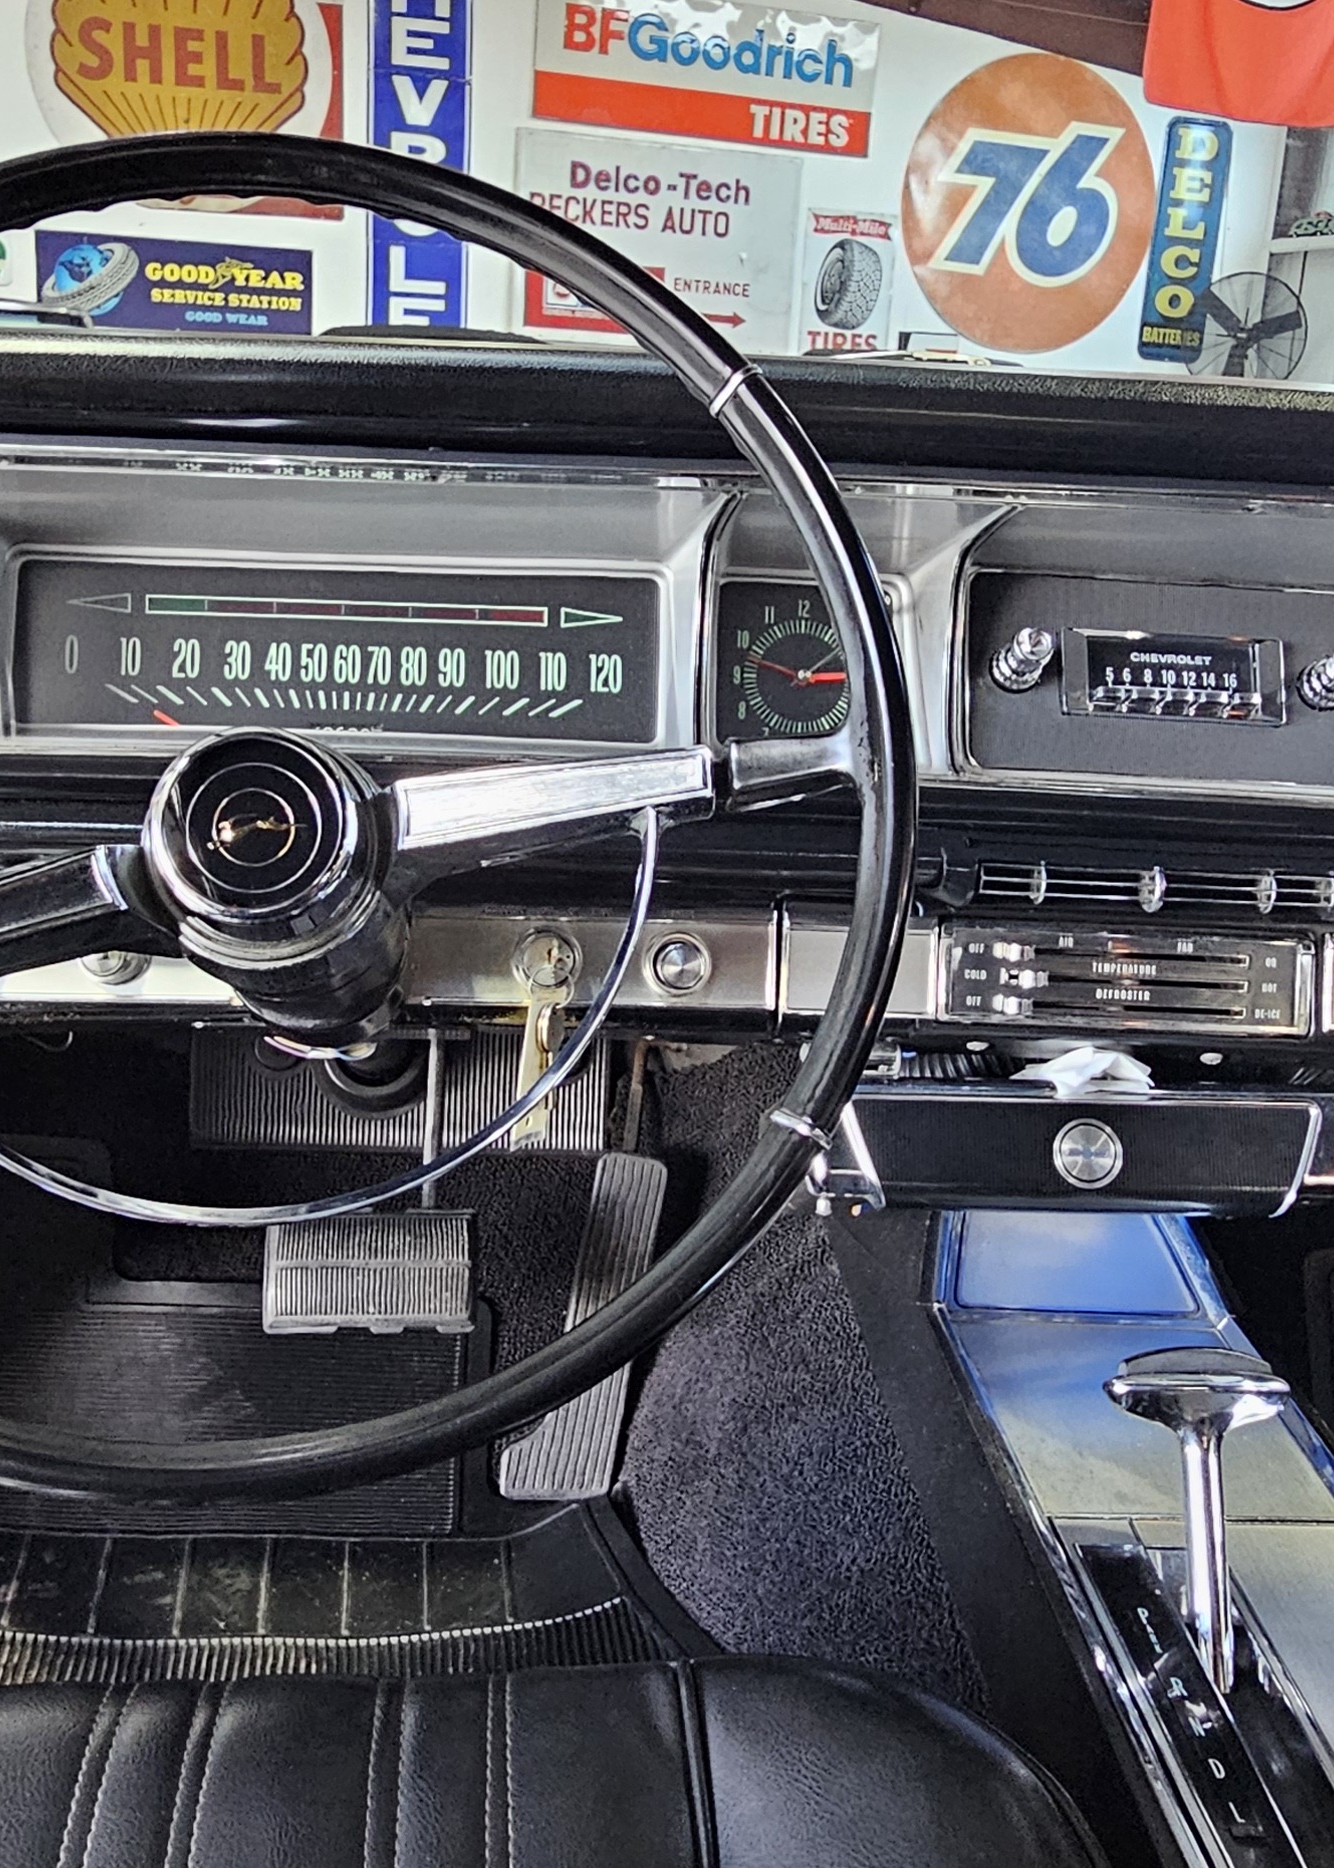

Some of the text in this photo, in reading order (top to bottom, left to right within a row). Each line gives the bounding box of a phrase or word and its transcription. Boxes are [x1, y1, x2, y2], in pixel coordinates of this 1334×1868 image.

[77, 16, 282, 94] SHELL
[564, 3, 854, 88] BFGoodrich
[749, 103, 851, 148] TIRES
[570, 160, 751, 206] Delco-Tech
[928, 120, 1127, 288] 76
[661, 206, 730, 238] AUTO
[1154, 126, 1220, 319] DELCO
[673, 277, 750, 297] ENTRANCE
[150, 288, 303, 312] SERVICE STATION
[185, 311, 269, 326] GOOD WEAR
[807, 331, 878, 351] TIRES
[1141, 325, 1201, 347] BATTERIES
[765, 605, 775, 625] 11
[798, 600, 811, 618] 12
[737, 629, 750, 649] 10
[65, 635, 623, 693] 0 10 20 30 40 50 60 70 80 90 100 110 120
[1130, 651, 1213, 666] CHEVROLET
[732, 665, 742, 685] 9
[1105, 667, 1237, 688] 5 6 8 10 12 14 16
[737, 700, 747, 720] 8
[968, 943, 985, 954] OFF
[964, 969, 987, 980] COLD
[1092, 962, 1157, 976] TEMPERATURE
[966, 995, 982, 1006] OFF
[1095, 988, 1151, 1001] DEFROSTER
[1254, 1008, 1281, 1019] DE-ICE
[1208, 1757, 1226, 1780] D
[1228, 1801, 1246, 1824] L
